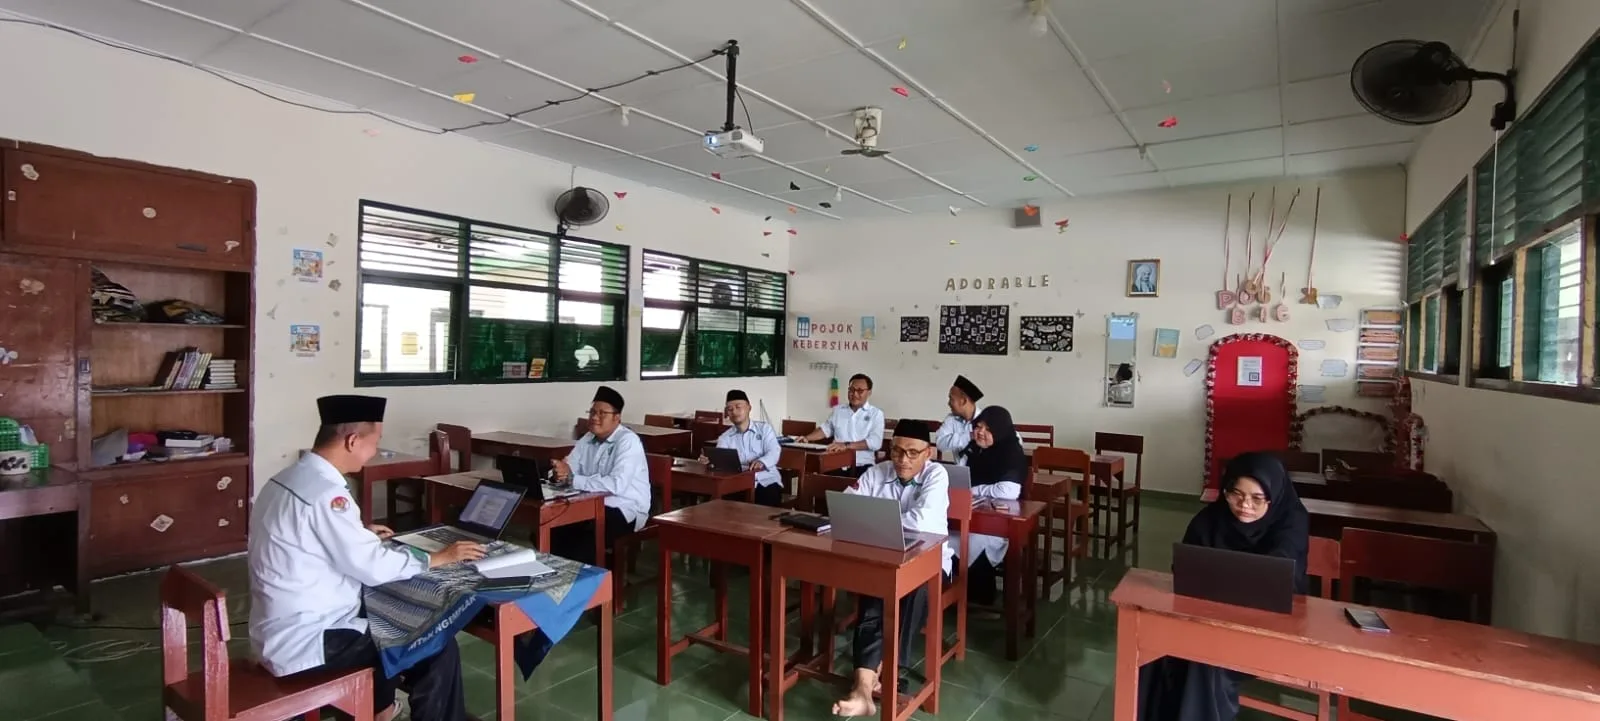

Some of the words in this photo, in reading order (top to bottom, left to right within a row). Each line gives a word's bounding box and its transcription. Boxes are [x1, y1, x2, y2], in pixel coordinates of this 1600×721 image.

[945, 275, 1049, 291] ADORABLE
[811, 324, 852, 333] POJOK
[792, 340, 869, 351] KEBERSIHAN
